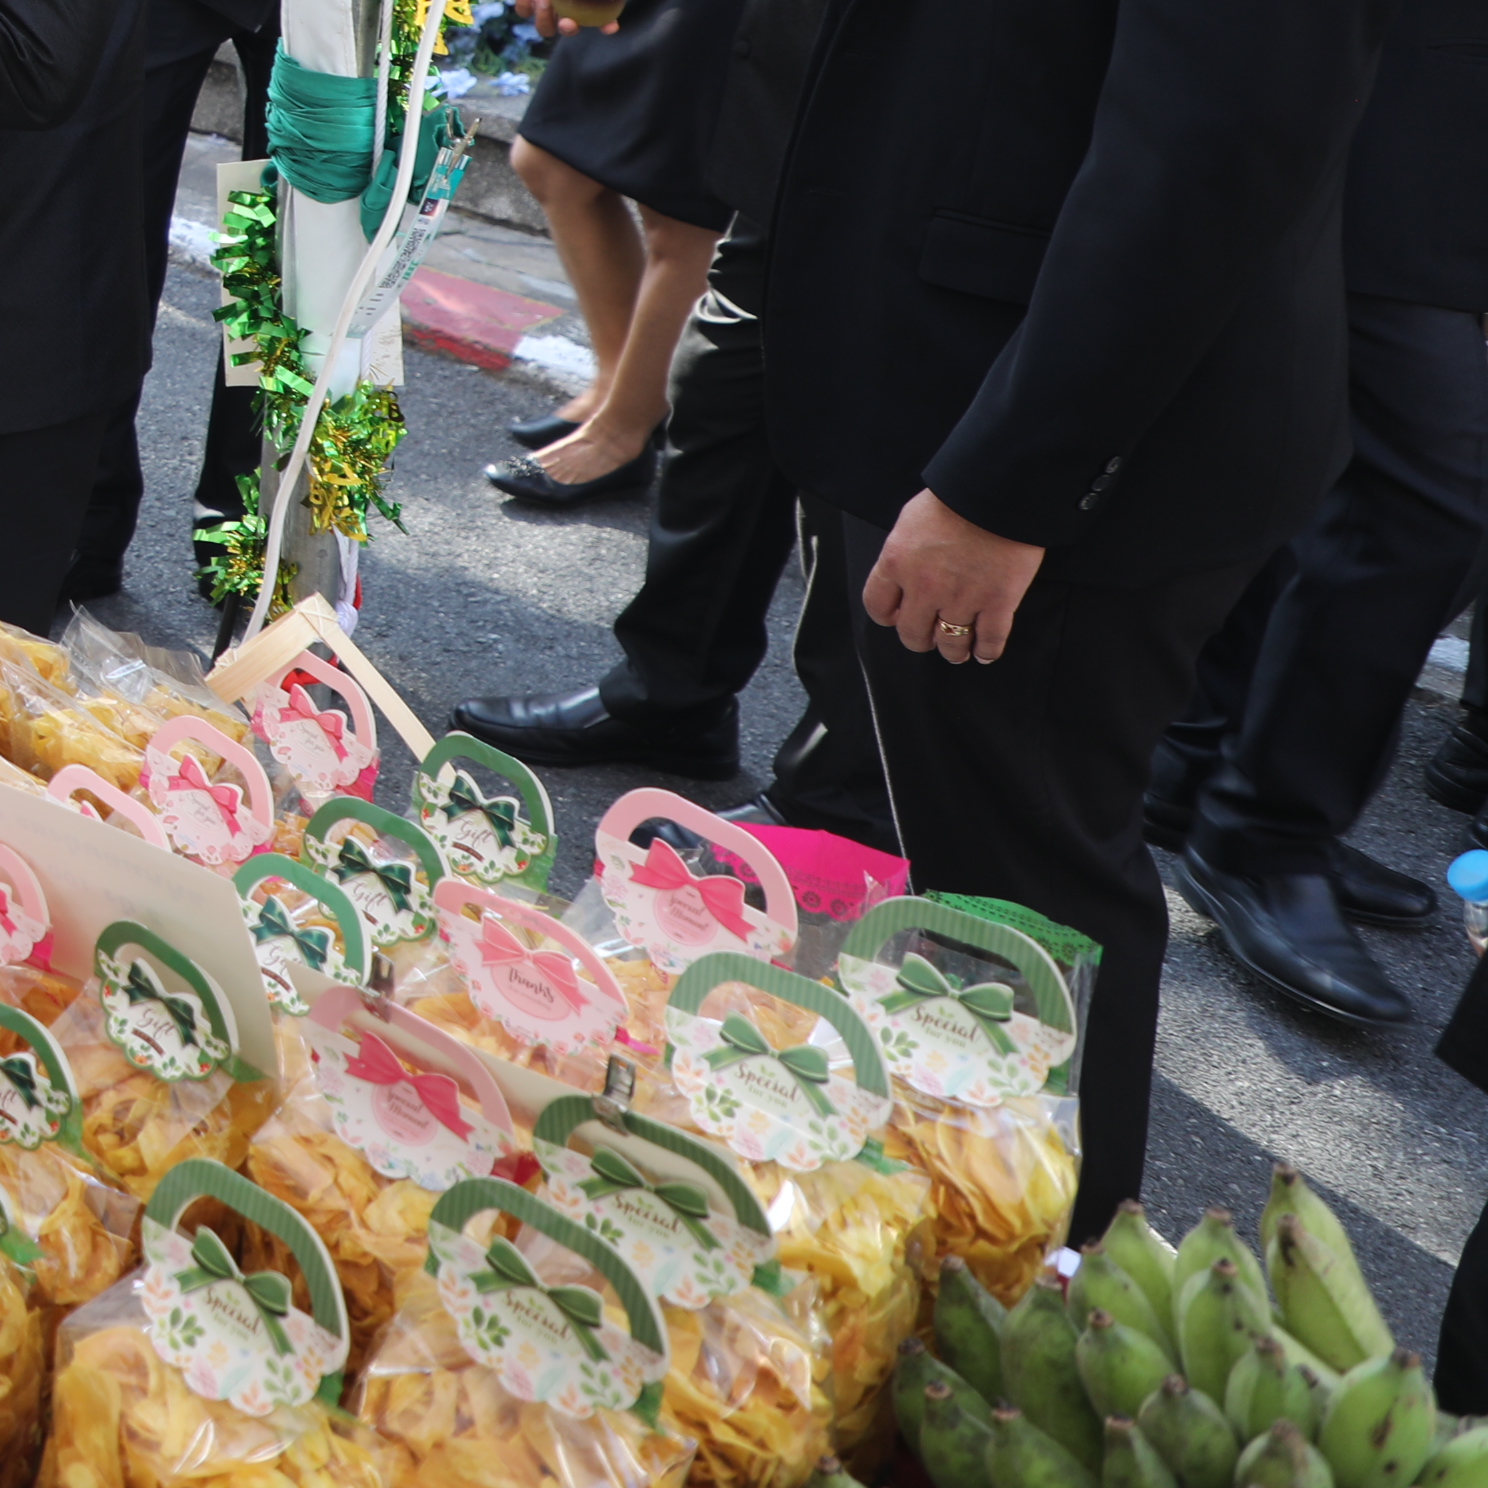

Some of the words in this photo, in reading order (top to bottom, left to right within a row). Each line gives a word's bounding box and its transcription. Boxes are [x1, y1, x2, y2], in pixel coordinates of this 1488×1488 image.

[455, 818, 497, 850] Gift
[353, 881, 390, 913] Gift
[508, 967, 554, 1004] Thanks
[137, 1007, 176, 1040] Gift
[911, 1003, 979, 1043] Special
[925, 1024, 941, 1039] for
[945, 1033, 967, 1049] you
[734, 1062, 800, 1102] Special
[611, 1193, 680, 1233] Special
[204, 1286, 261, 1335] Special
[502, 1290, 569, 1341] Special
